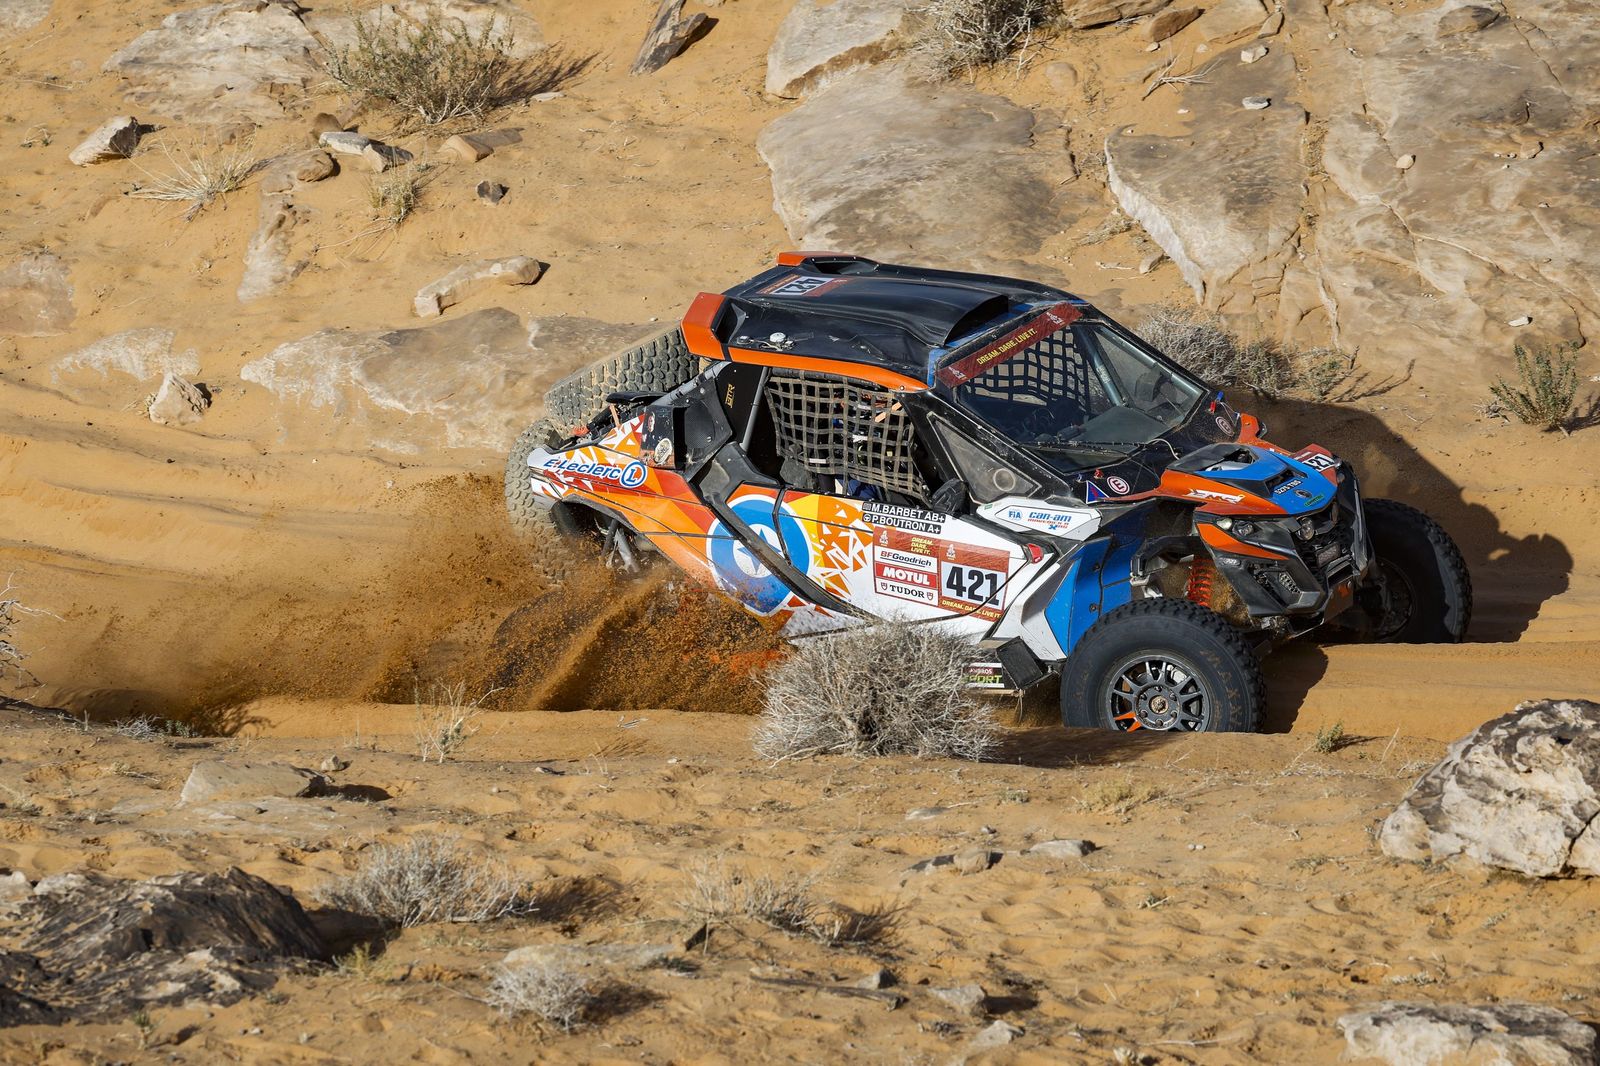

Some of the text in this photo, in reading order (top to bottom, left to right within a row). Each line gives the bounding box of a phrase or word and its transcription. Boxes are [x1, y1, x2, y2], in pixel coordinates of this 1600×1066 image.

[976, 350, 1000, 365] DREAM.
[999, 340, 1018, 354] DARE.
[1015, 331, 1030, 344] LIVE
[871, 503, 924, 518] M.BARBET
[924, 513, 945, 523] AB+
[1028, 511, 1072, 522] can-am
[872, 514, 941, 534] P.BOUTRON A+
[911, 537, 934, 546] DREAM.
[911, 542, 928, 550] DARE.
[880, 550, 932, 566] BFGoodrich
[882, 566, 931, 585] MOTUL
[889, 584, 925, 598] TUDOR
[946, 565, 1000, 606] 421
[941, 600, 964, 610] DREAM.
